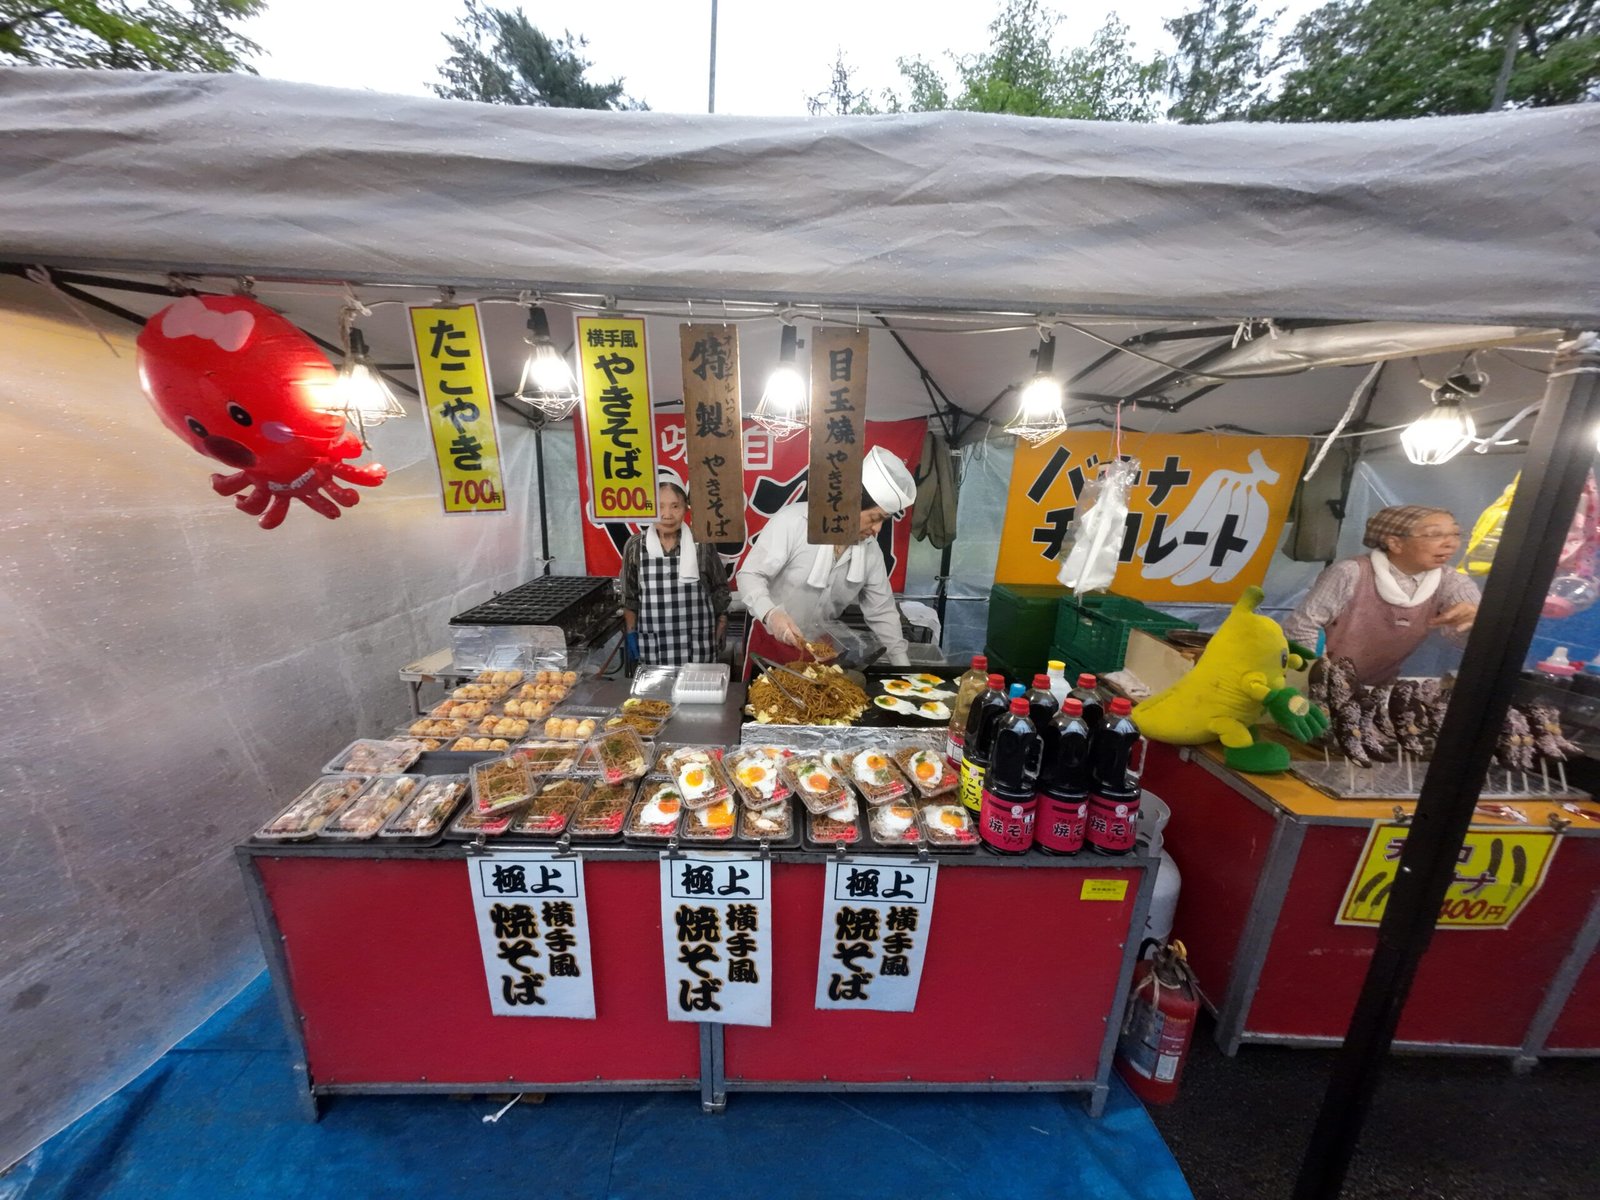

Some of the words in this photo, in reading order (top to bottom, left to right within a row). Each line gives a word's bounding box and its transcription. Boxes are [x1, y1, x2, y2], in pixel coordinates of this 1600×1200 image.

[587, 329, 638, 348] 横手風
[430, 320, 484, 471] たこやき
[594, 352, 642, 480] やきそば
[448, 480, 501, 504] 700円
[601, 487, 653, 511] 600円
[702, 454, 731, 537] やきそば
[822, 450, 849, 534] やきそば
[492, 864, 564, 894] 極上
[681, 863, 751, 896] 極上
[846, 867, 915, 899] 極上
[490, 903, 546, 1006] 焼そば
[542, 901, 580, 977] 横手風
[675, 904, 722, 1012] 焼そば
[726, 904, 759, 983] 横手風
[828, 906, 880, 1001] 焼そば
[880, 906, 919, 977] 横手風
